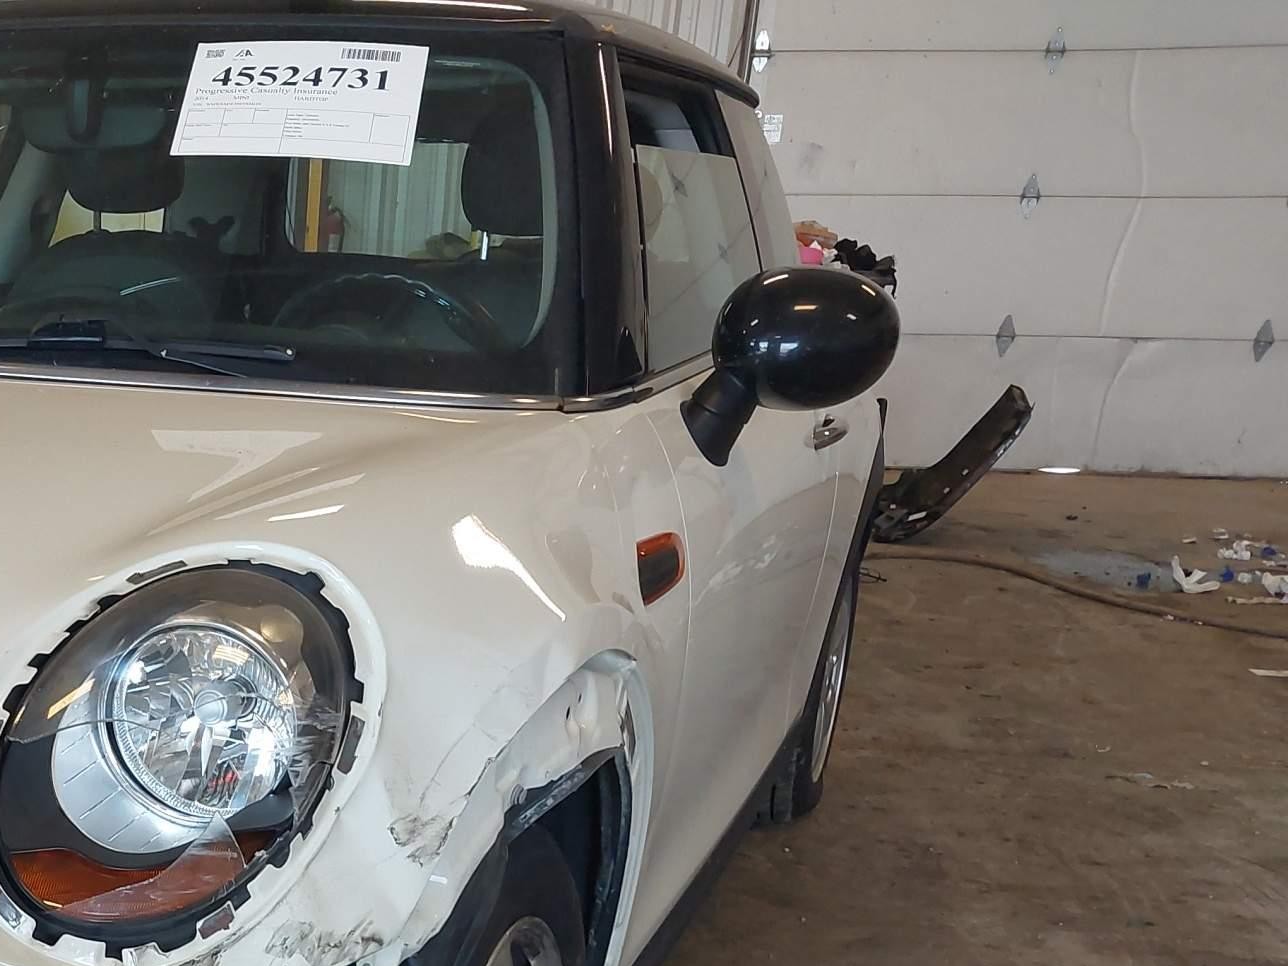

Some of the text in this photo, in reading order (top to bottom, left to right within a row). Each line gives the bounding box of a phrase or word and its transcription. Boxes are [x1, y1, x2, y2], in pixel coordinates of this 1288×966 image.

[211, 66, 390, 92] 45524731
[195, 87, 339, 96] Progressive Casualty Insurance
